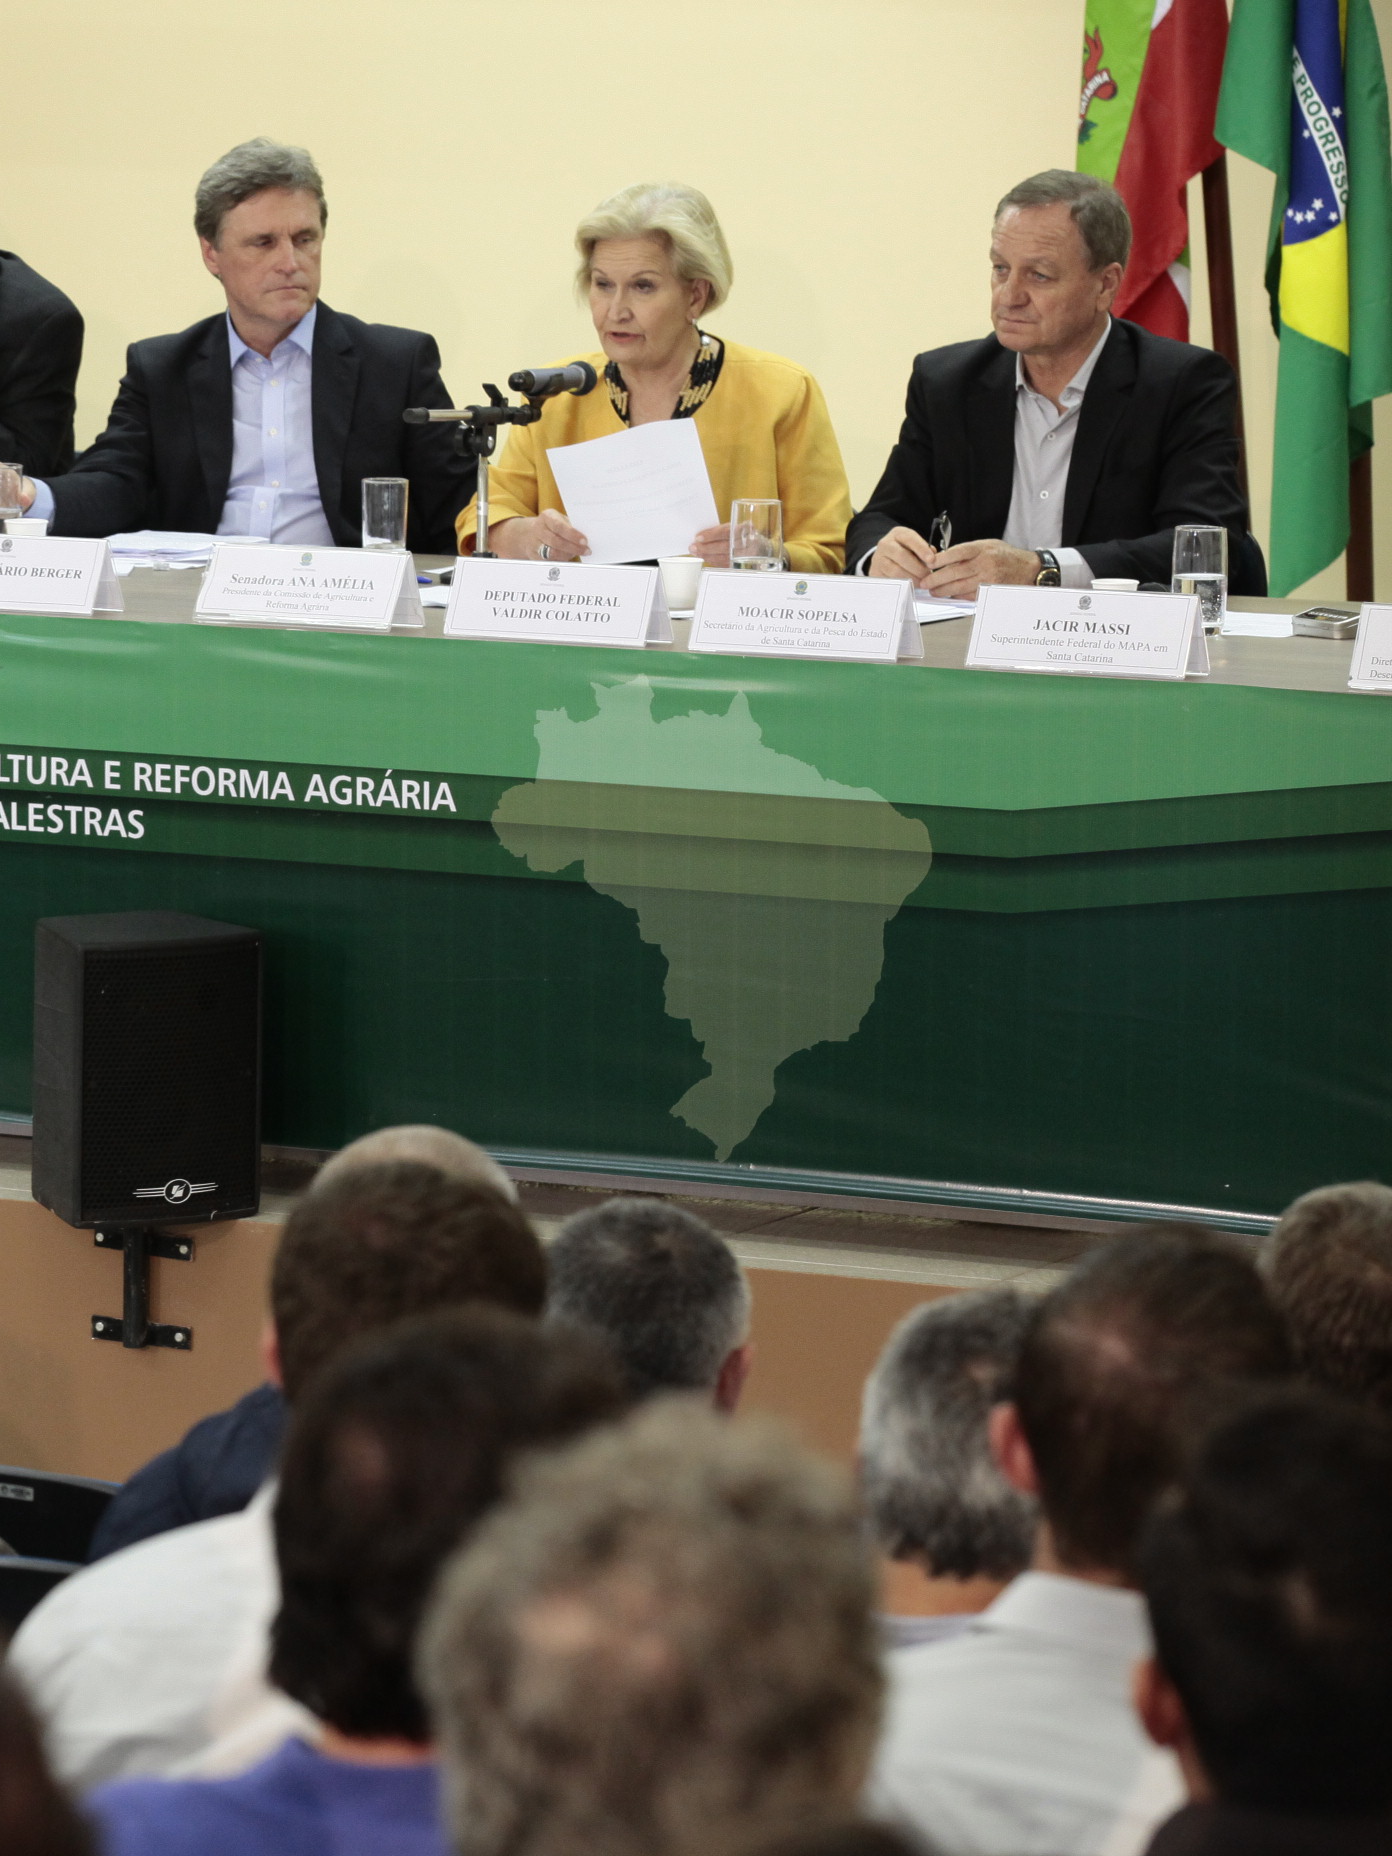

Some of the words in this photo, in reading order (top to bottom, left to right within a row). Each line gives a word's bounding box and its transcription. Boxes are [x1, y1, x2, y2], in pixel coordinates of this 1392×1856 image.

[1296, 74, 1348, 204] PROGRESSO
[30, 568, 82, 579] BERGER
[230, 574, 284, 586] Senadora
[289, 576, 316, 588] ANA
[320, 576, 374, 590] AMÉLIA
[222, 587, 260, 597] Presidente
[262, 588, 273, 597] da
[274, 589, 310, 599] Comissão
[312, 591, 323, 600] de
[324, 592, 366, 603] Agricultura
[484, 590, 556, 604] DEPUTADO
[560, 594, 620, 608] FEDERAL
[266, 600, 298, 610] Reforma
[300, 602, 330, 612] Agrária
[492, 607, 542, 620] VALDIR
[546, 610, 610, 624] COLATTO
[738, 606, 794, 620] MOACIR
[797, 609, 858, 624] SOPELSA
[704, 620, 742, 631] Secretário
[745, 623, 754, 632] da
[756, 624, 802, 635] Agricultura
[811, 626, 821, 634] da
[823, 626, 845, 636] Pesca
[848, 628, 858, 637] do
[860, 628, 888, 638] Estado
[1032, 618, 1078, 633] JACIR
[1083, 622, 1131, 636] MASSI
[761, 636, 770, 645] de
[772, 638, 795, 646] Santa
[797, 638, 830, 648] Catarina
[990, 634, 1064, 646] Superintendente
[1066, 638, 1102, 649] Federal
[1104, 640, 1115, 650] do
[1118, 642, 1150, 652] MAPA
[1046, 651, 1072, 662] Santa
[1074, 652, 1113, 664] Catarina
[104, 760, 121, 790] E
[133, 762, 294, 802] REFORMA
[304, 769, 458, 812] AGRÁRIA
